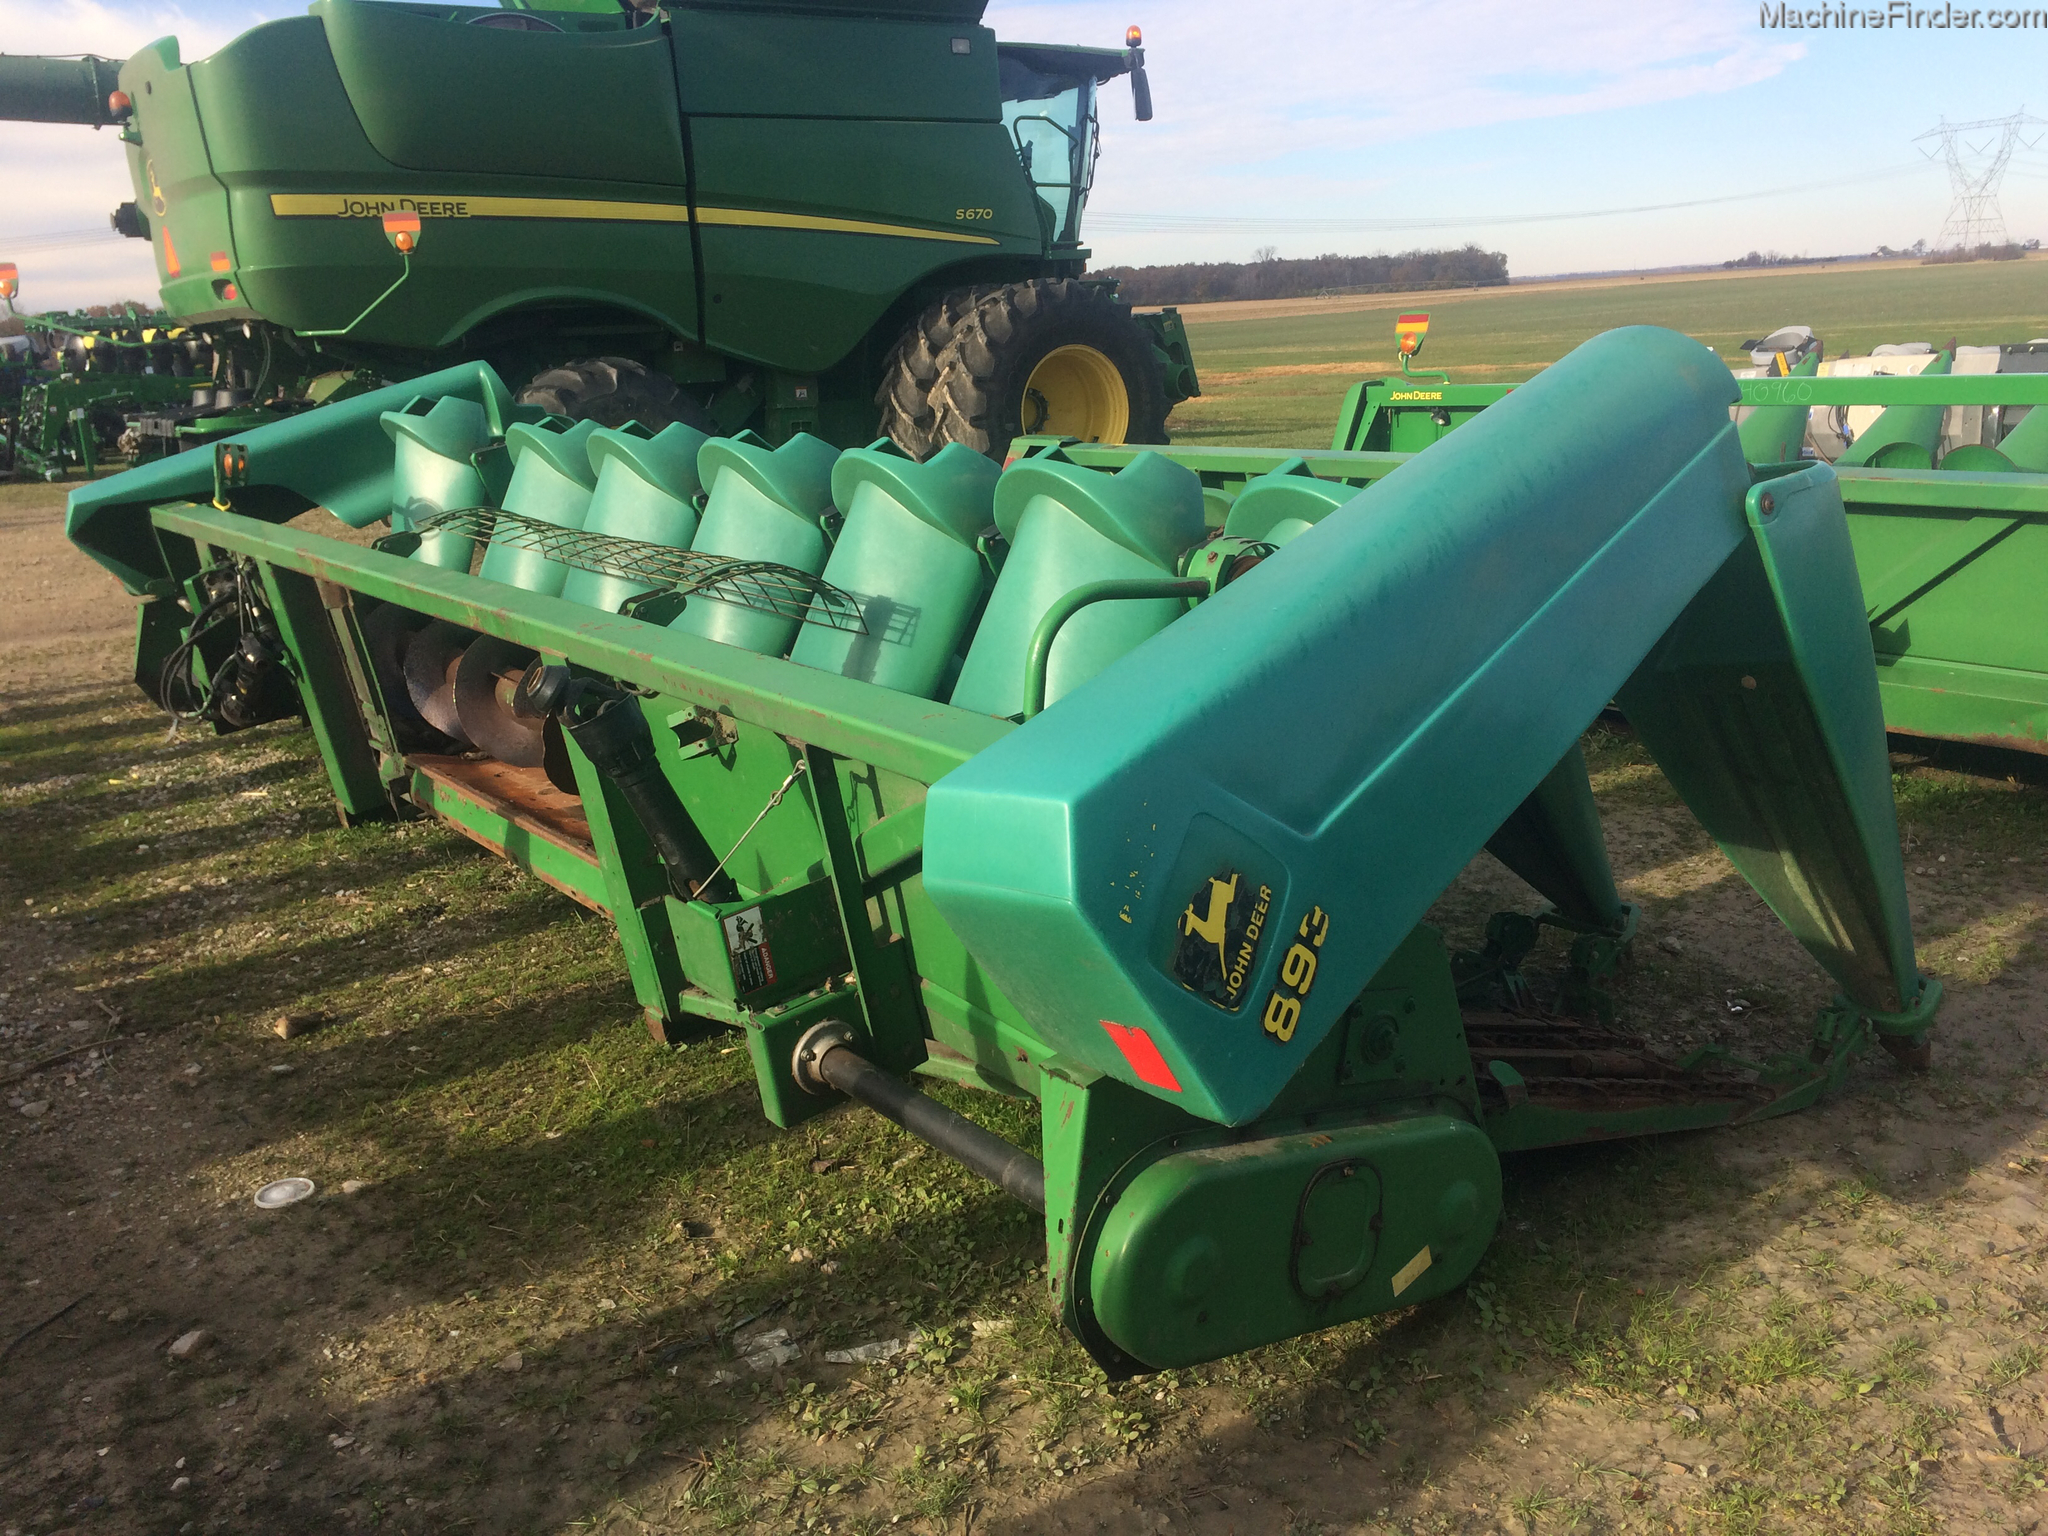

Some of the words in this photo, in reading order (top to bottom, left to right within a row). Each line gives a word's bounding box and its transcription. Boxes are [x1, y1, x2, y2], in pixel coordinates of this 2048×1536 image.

[338, 199, 394, 215] JOHN
[400, 199, 468, 215] DEERE
[956, 208, 993, 220] S670
[1390, 391, 1413, 400] JOHN
[1413, 391, 1442, 400] DEERE
[1225, 942, 1253, 999] JOHN
[1264, 905, 1330, 1042] 893
